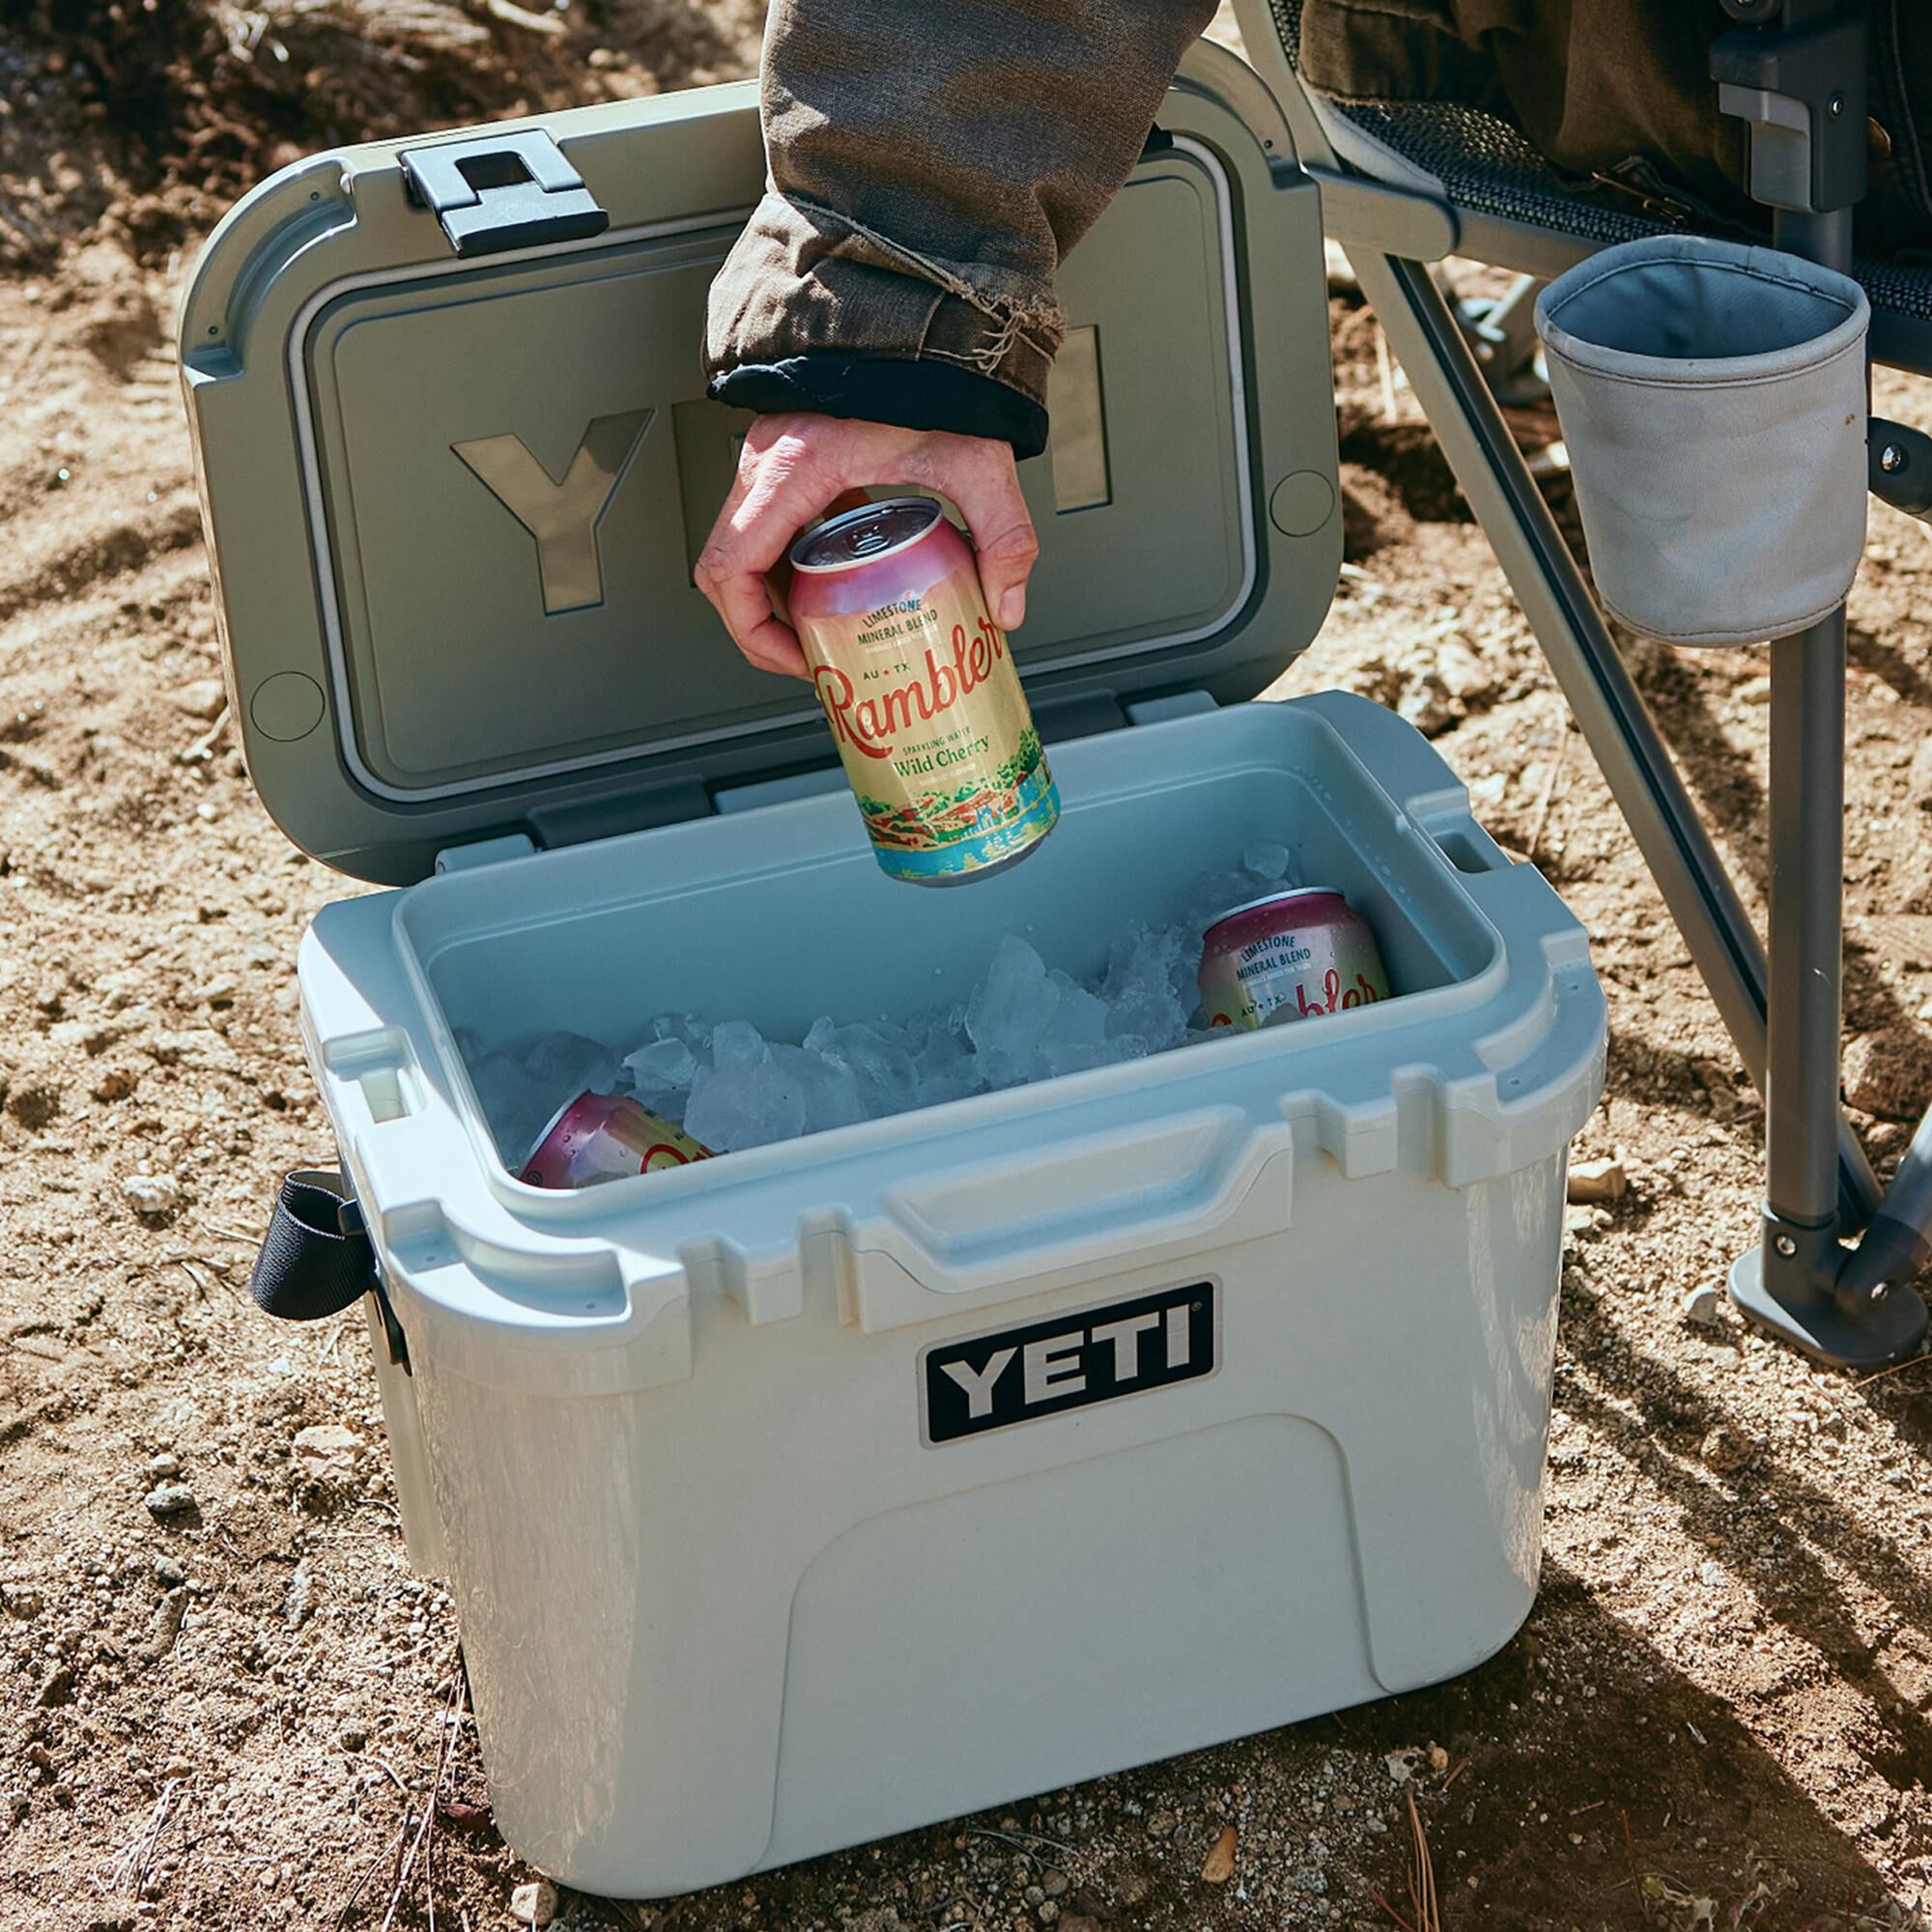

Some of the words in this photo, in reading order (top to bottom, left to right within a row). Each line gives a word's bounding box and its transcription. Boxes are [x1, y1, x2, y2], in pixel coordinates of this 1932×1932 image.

[858, 624, 904, 644] MINERAL
[905, 609, 938, 631] BLEND
[862, 599, 922, 628] LIMESTONE
[814, 615, 1003, 758] Rambler
[863, 669, 879, 680] AU
[894, 663, 910, 672] TX
[893, 754, 934, 777] Wild
[935, 735, 989, 768] Cherry
[902, 736, 945, 755] SPARKLING
[946, 725, 971, 743] WATER
[1236, 954, 1279, 981] MINERAL
[1279, 948, 1312, 966] BLEND
[1240, 934, 1295, 962] LIMESTONE
[939, 1303, 1190, 1419] YETI
